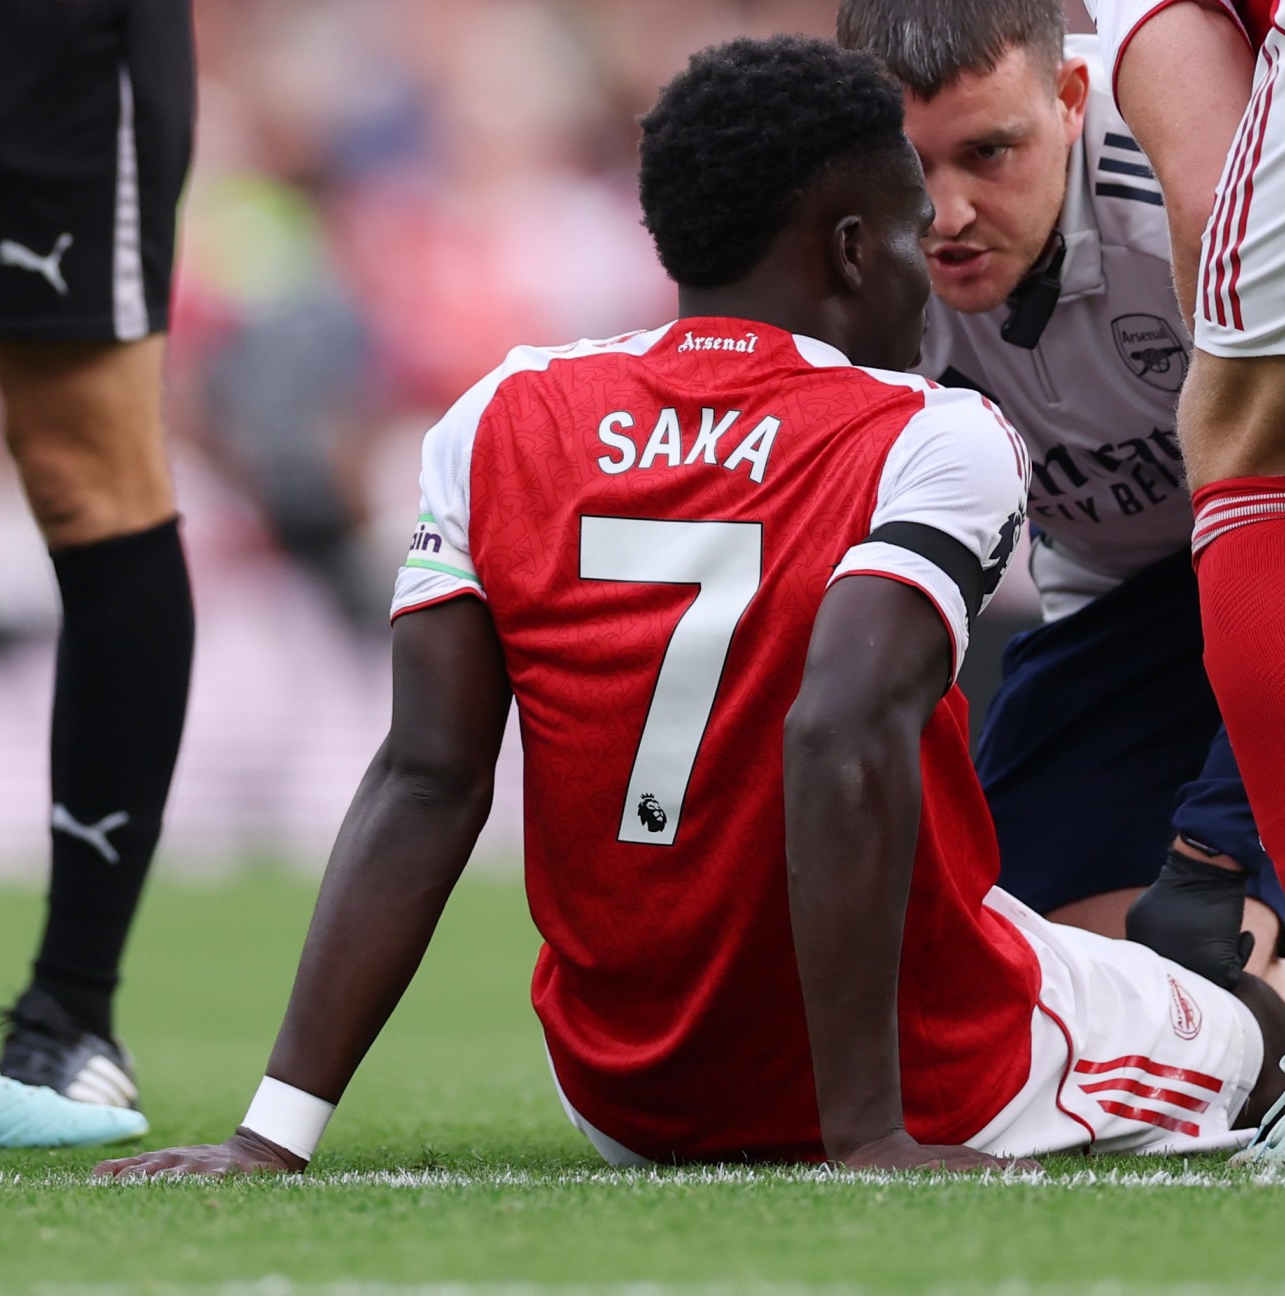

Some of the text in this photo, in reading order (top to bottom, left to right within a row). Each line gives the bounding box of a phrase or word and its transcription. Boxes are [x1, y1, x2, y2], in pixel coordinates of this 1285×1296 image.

[677, 331, 759, 354] Arsenal
[597, 406, 782, 485] SAKA
[580, 514, 763, 846] 7
